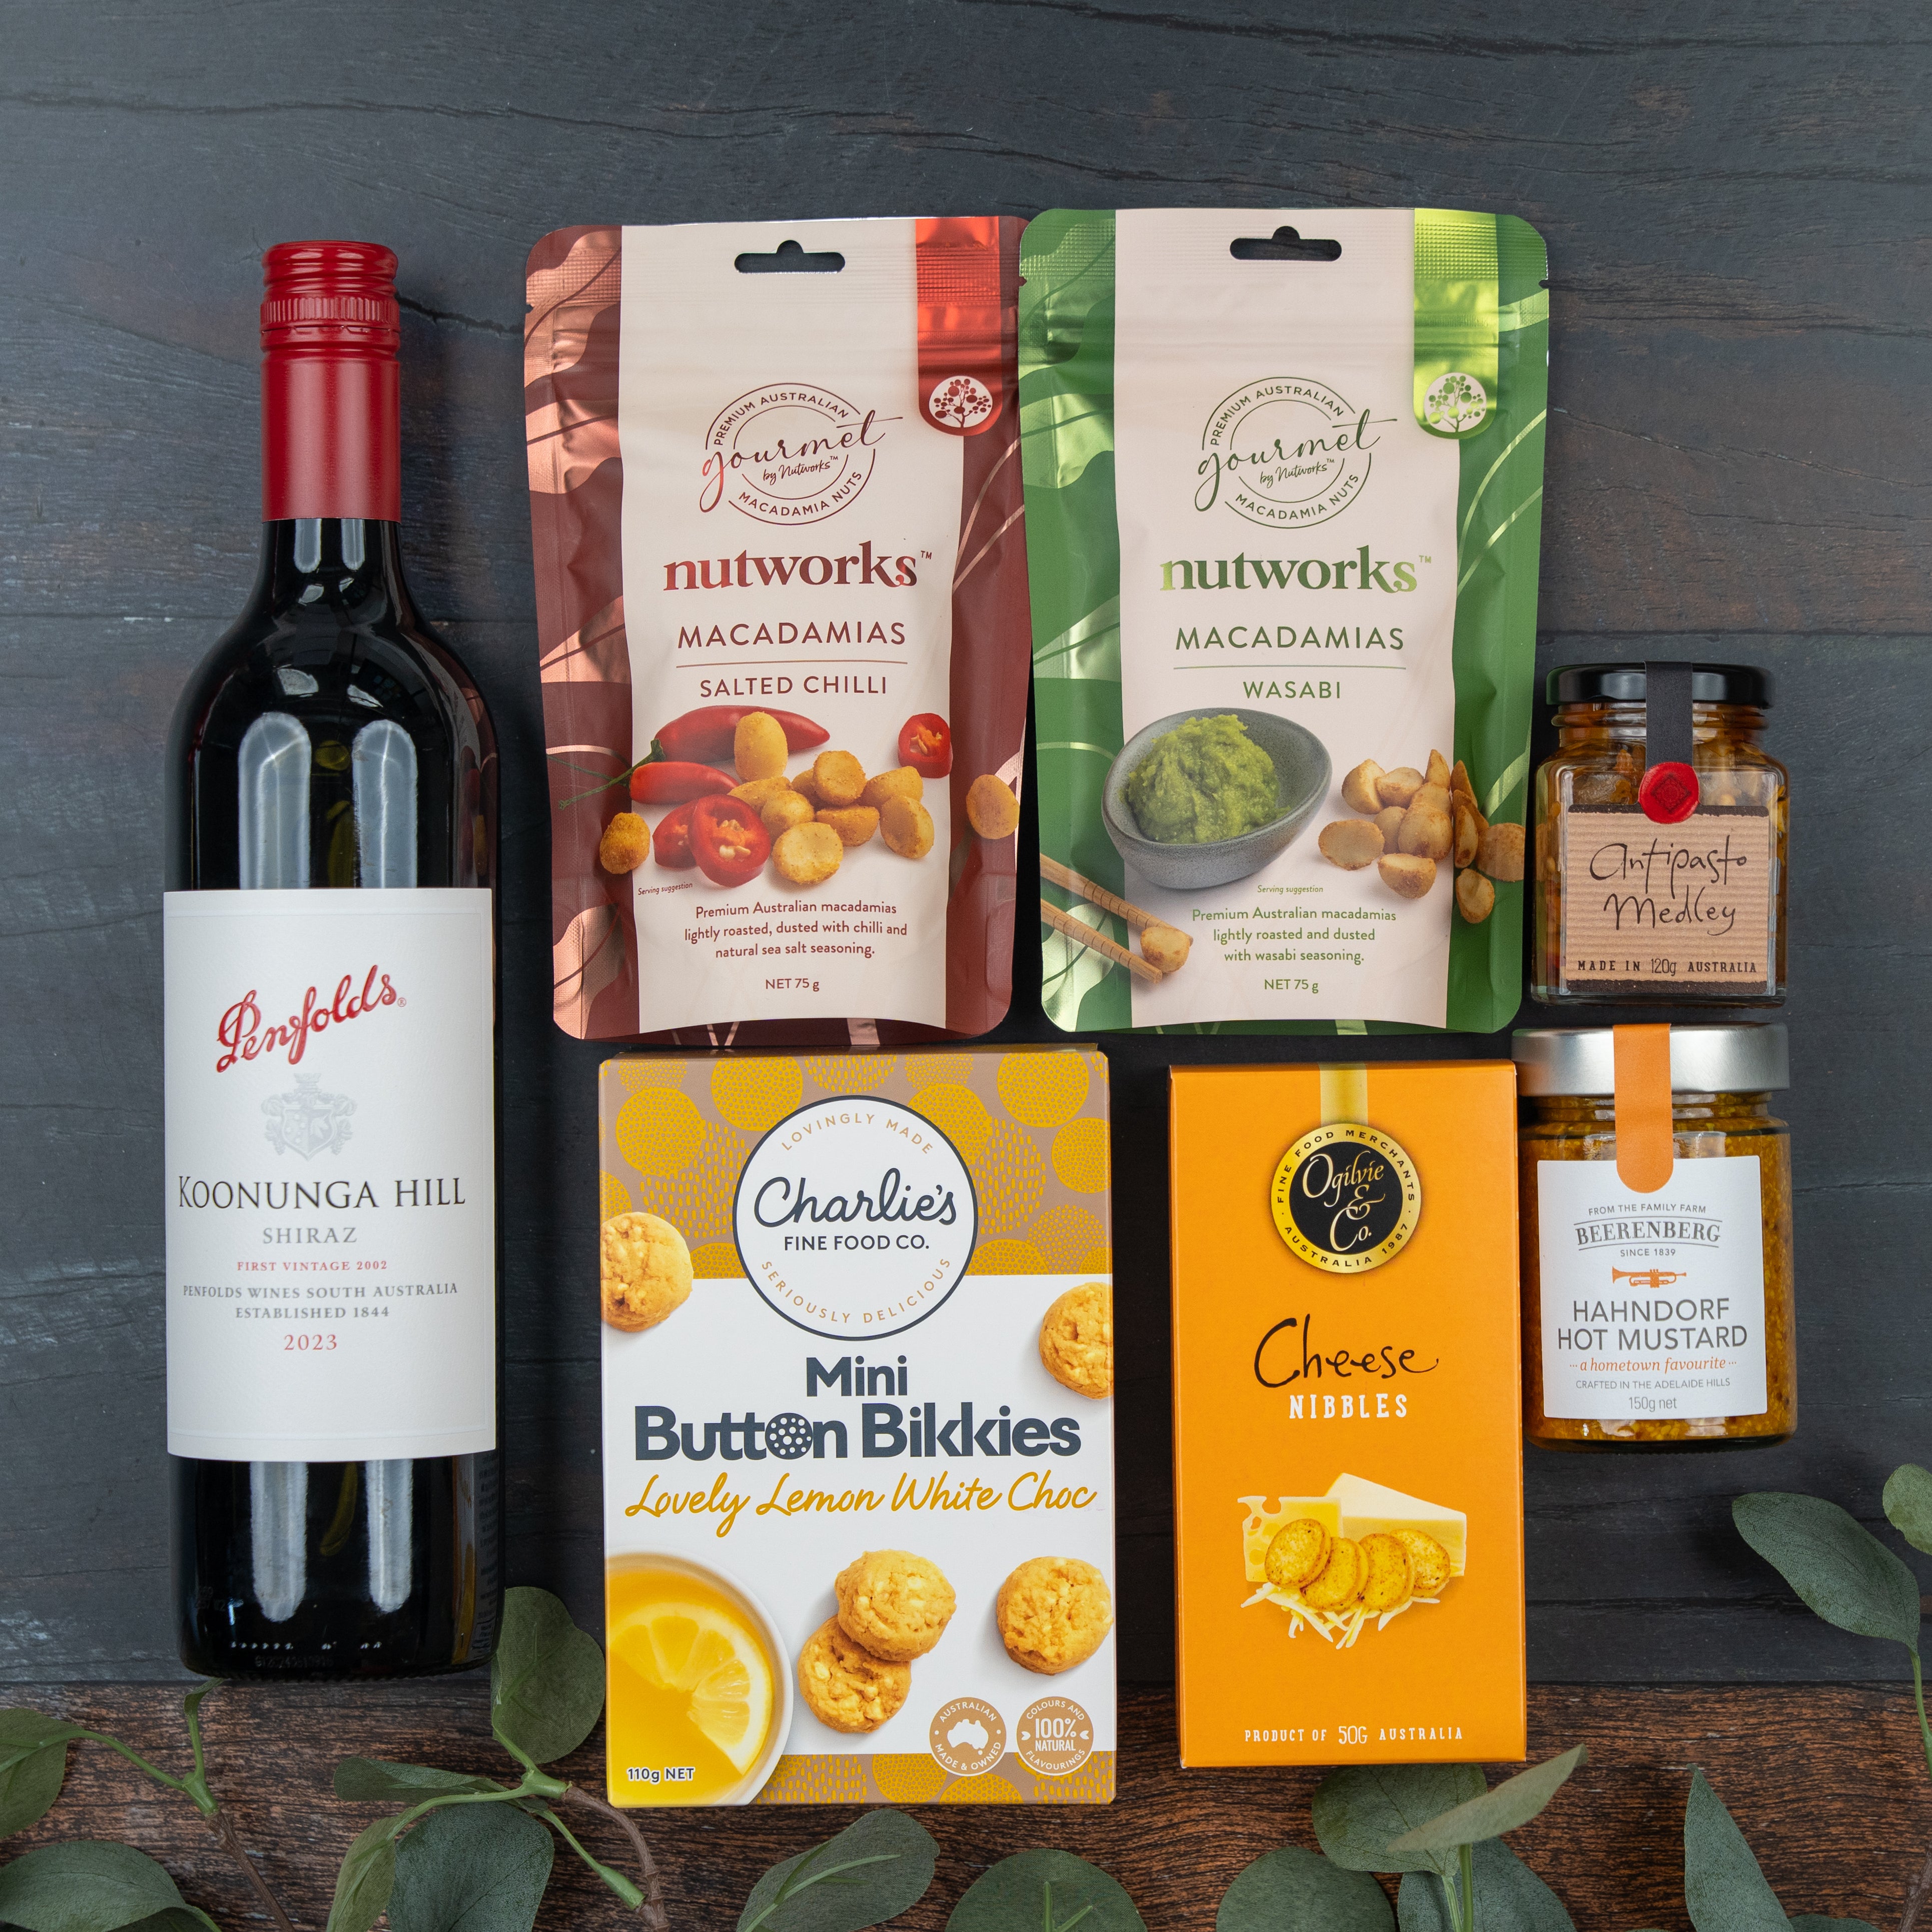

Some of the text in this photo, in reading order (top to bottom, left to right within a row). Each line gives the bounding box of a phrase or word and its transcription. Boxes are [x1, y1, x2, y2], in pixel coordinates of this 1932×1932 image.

[713, 391, 849, 446] PREMIUM AUSTRALIAN
[1210, 385, 1345, 446] PREMIUM AUSTRALIAN
[699, 409, 903, 513] gourmet
[1194, 408, 1398, 512] gourmet
[763, 469, 777, 485] by
[1259, 471, 1273, 488] by
[738, 470, 863, 517] MACADAMIA NUTS
[1235, 474, 1359, 520] MACADAMIA NUTS
[677, 621, 906, 650] MACADAMIAS
[1175, 625, 1404, 651] MACADAMIAS
[700, 676, 887, 698] SALTED CHILLI
[1242, 681, 1341, 699] WASABI
[1589, 834, 1748, 899] Antipasto
[637, 882, 693, 896] Serving suggestion
[1257, 885, 1324, 895] Serving suggestion
[696, 900, 897, 919] Premium Australian macadamias
[1192, 906, 1397, 922] Premium Australian macadamias
[1603, 884, 1736, 936] Medley
[684, 920, 908, 944] lightly roasted, dusted with chilli and
[1213, 928, 1376, 945] lightly roasted and dusted
[716, 941, 875, 959] natural sea salt seasoning.
[1224, 949, 1365, 966] with wasabi seasoning.
[1578, 958, 1757, 976] MADE IN 120g AUSTRALIA
[765, 978, 820, 992] NET 75 g
[1264, 979, 1320, 994] NET 75 g
[781, 1113, 933, 1154] LOVINGLY MADE
[1277, 1129, 1415, 1203] FINE FOOD MERCHANTS
[1302, 1150, 1384, 1208] Ogilvie
[178, 1175, 466, 1210] KOONUNGA HILL
[754, 1167, 957, 1228] Charlie's
[1346, 1184, 1386, 1221] &
[1588, 1203, 1707, 1216] FROM THE FAMILY FARM
[262, 1226, 358, 1244] SHIRAZ
[1330, 1206, 1372, 1252] Co.
[1575, 1220, 1721, 1246] BEERENBERG
[784, 1234, 930, 1251] FINE FOOD CO.
[1284, 1223, 1409, 1267] AUSTRALIA 1987
[1620, 1248, 1676, 1257] SINCE 1839
[236, 1260, 388, 1271] FIRST VINTAGE 2002
[183, 1282, 458, 1300] PENFOLDS WINES SOUTH AUSTRALIA
[761, 1258, 951, 1324] SERIOUSLY DELICIOUS
[235, 1307, 390, 1319] ESTABLISHED 1844
[1573, 1298, 1730, 1323] HAHNDORF
[284, 1335, 338, 1351] 2023
[1557, 1325, 1748, 1351] HOT MUSTARD
[1253, 1313, 1439, 1389] Cheese
[806, 1355, 908, 1398] Mini
[1580, 1357, 1726, 1375] a hometown favourite
[1575, 1378, 1730, 1390] CRAFTED IN THE ADELAIDE HILLS
[1289, 1393, 1407, 1419] NIBBLES
[1628, 1397, 1677, 1413] 150g net
[634, 1401, 1081, 1461] Button Bikkies
[624, 1469, 1098, 1538] Lovely Lemon White Choc
[939, 1701, 997, 1723] AUSTRALIAN
[1026, 1700, 1085, 1721] COLOURS AND
[1035, 1717, 1077, 1739] 100%
[1244, 1725, 1463, 1745] PRODUCT OF 50G AUSTRALIA
[935, 1741, 1001, 1771] MADE & OWNED
[1034, 1739, 1076, 1752] NATURAL
[1025, 1749, 1086, 1770] FLAVOURINGS
[627, 1767, 695, 1783] 110g NET
